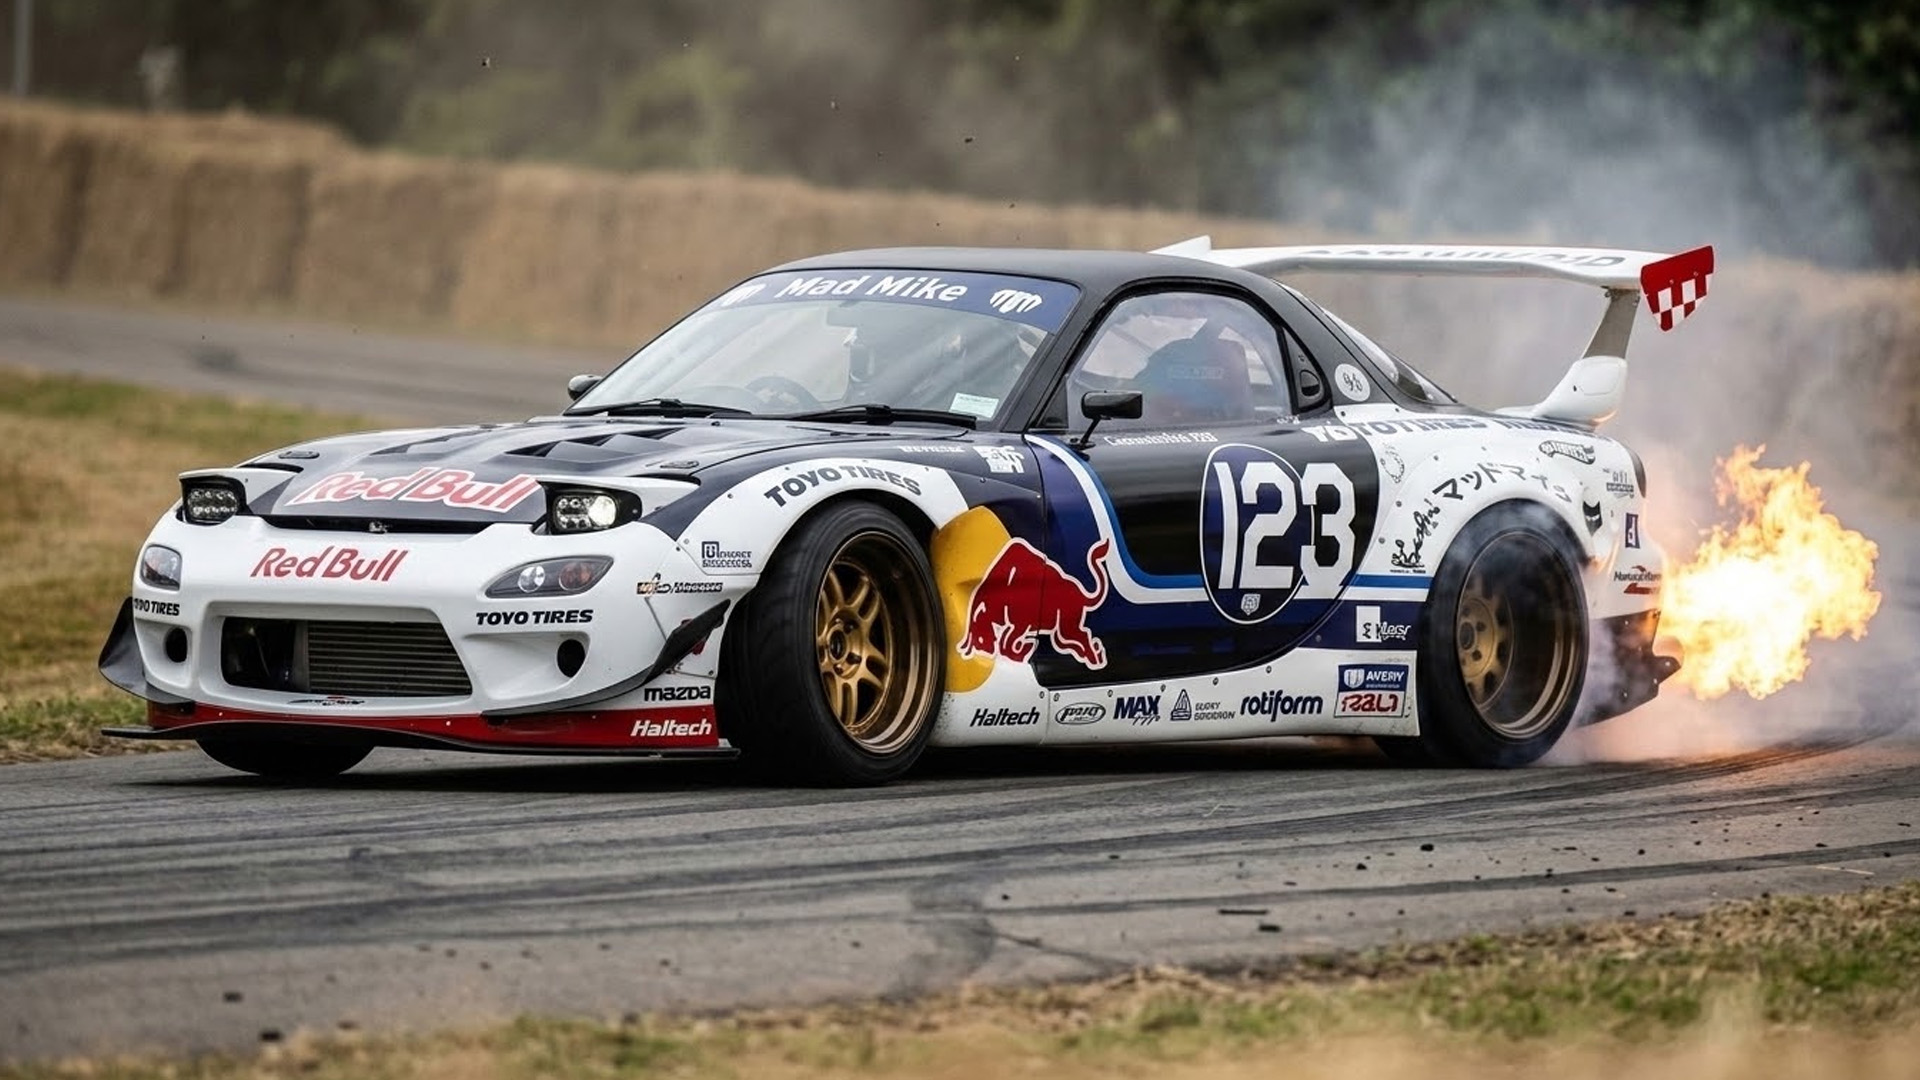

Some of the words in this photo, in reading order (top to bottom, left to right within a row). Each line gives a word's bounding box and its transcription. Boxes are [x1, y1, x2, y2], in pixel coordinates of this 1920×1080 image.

[774, 276, 869, 299] Mad
[865, 276, 968, 301] Mike
[286, 467, 436, 506] Red
[400, 468, 541, 513] Bull
[764, 466, 843, 508] TOYO
[842, 466, 922, 497] TIRES
[1215, 462, 1356, 599] 123
[250, 546, 335, 578] Red
[322, 549, 409, 582] Bull
[151, 601, 180, 616] TIRES
[476, 611, 529, 626] TOYO
[532, 609, 594, 624] TIRES
[644, 686, 711, 702] mazda
[1240, 690, 1323, 722] rotiform
[970, 707, 1040, 727] Haltech
[1113, 695, 1161, 720] MAX
[631, 719, 712, 737] Haltech
